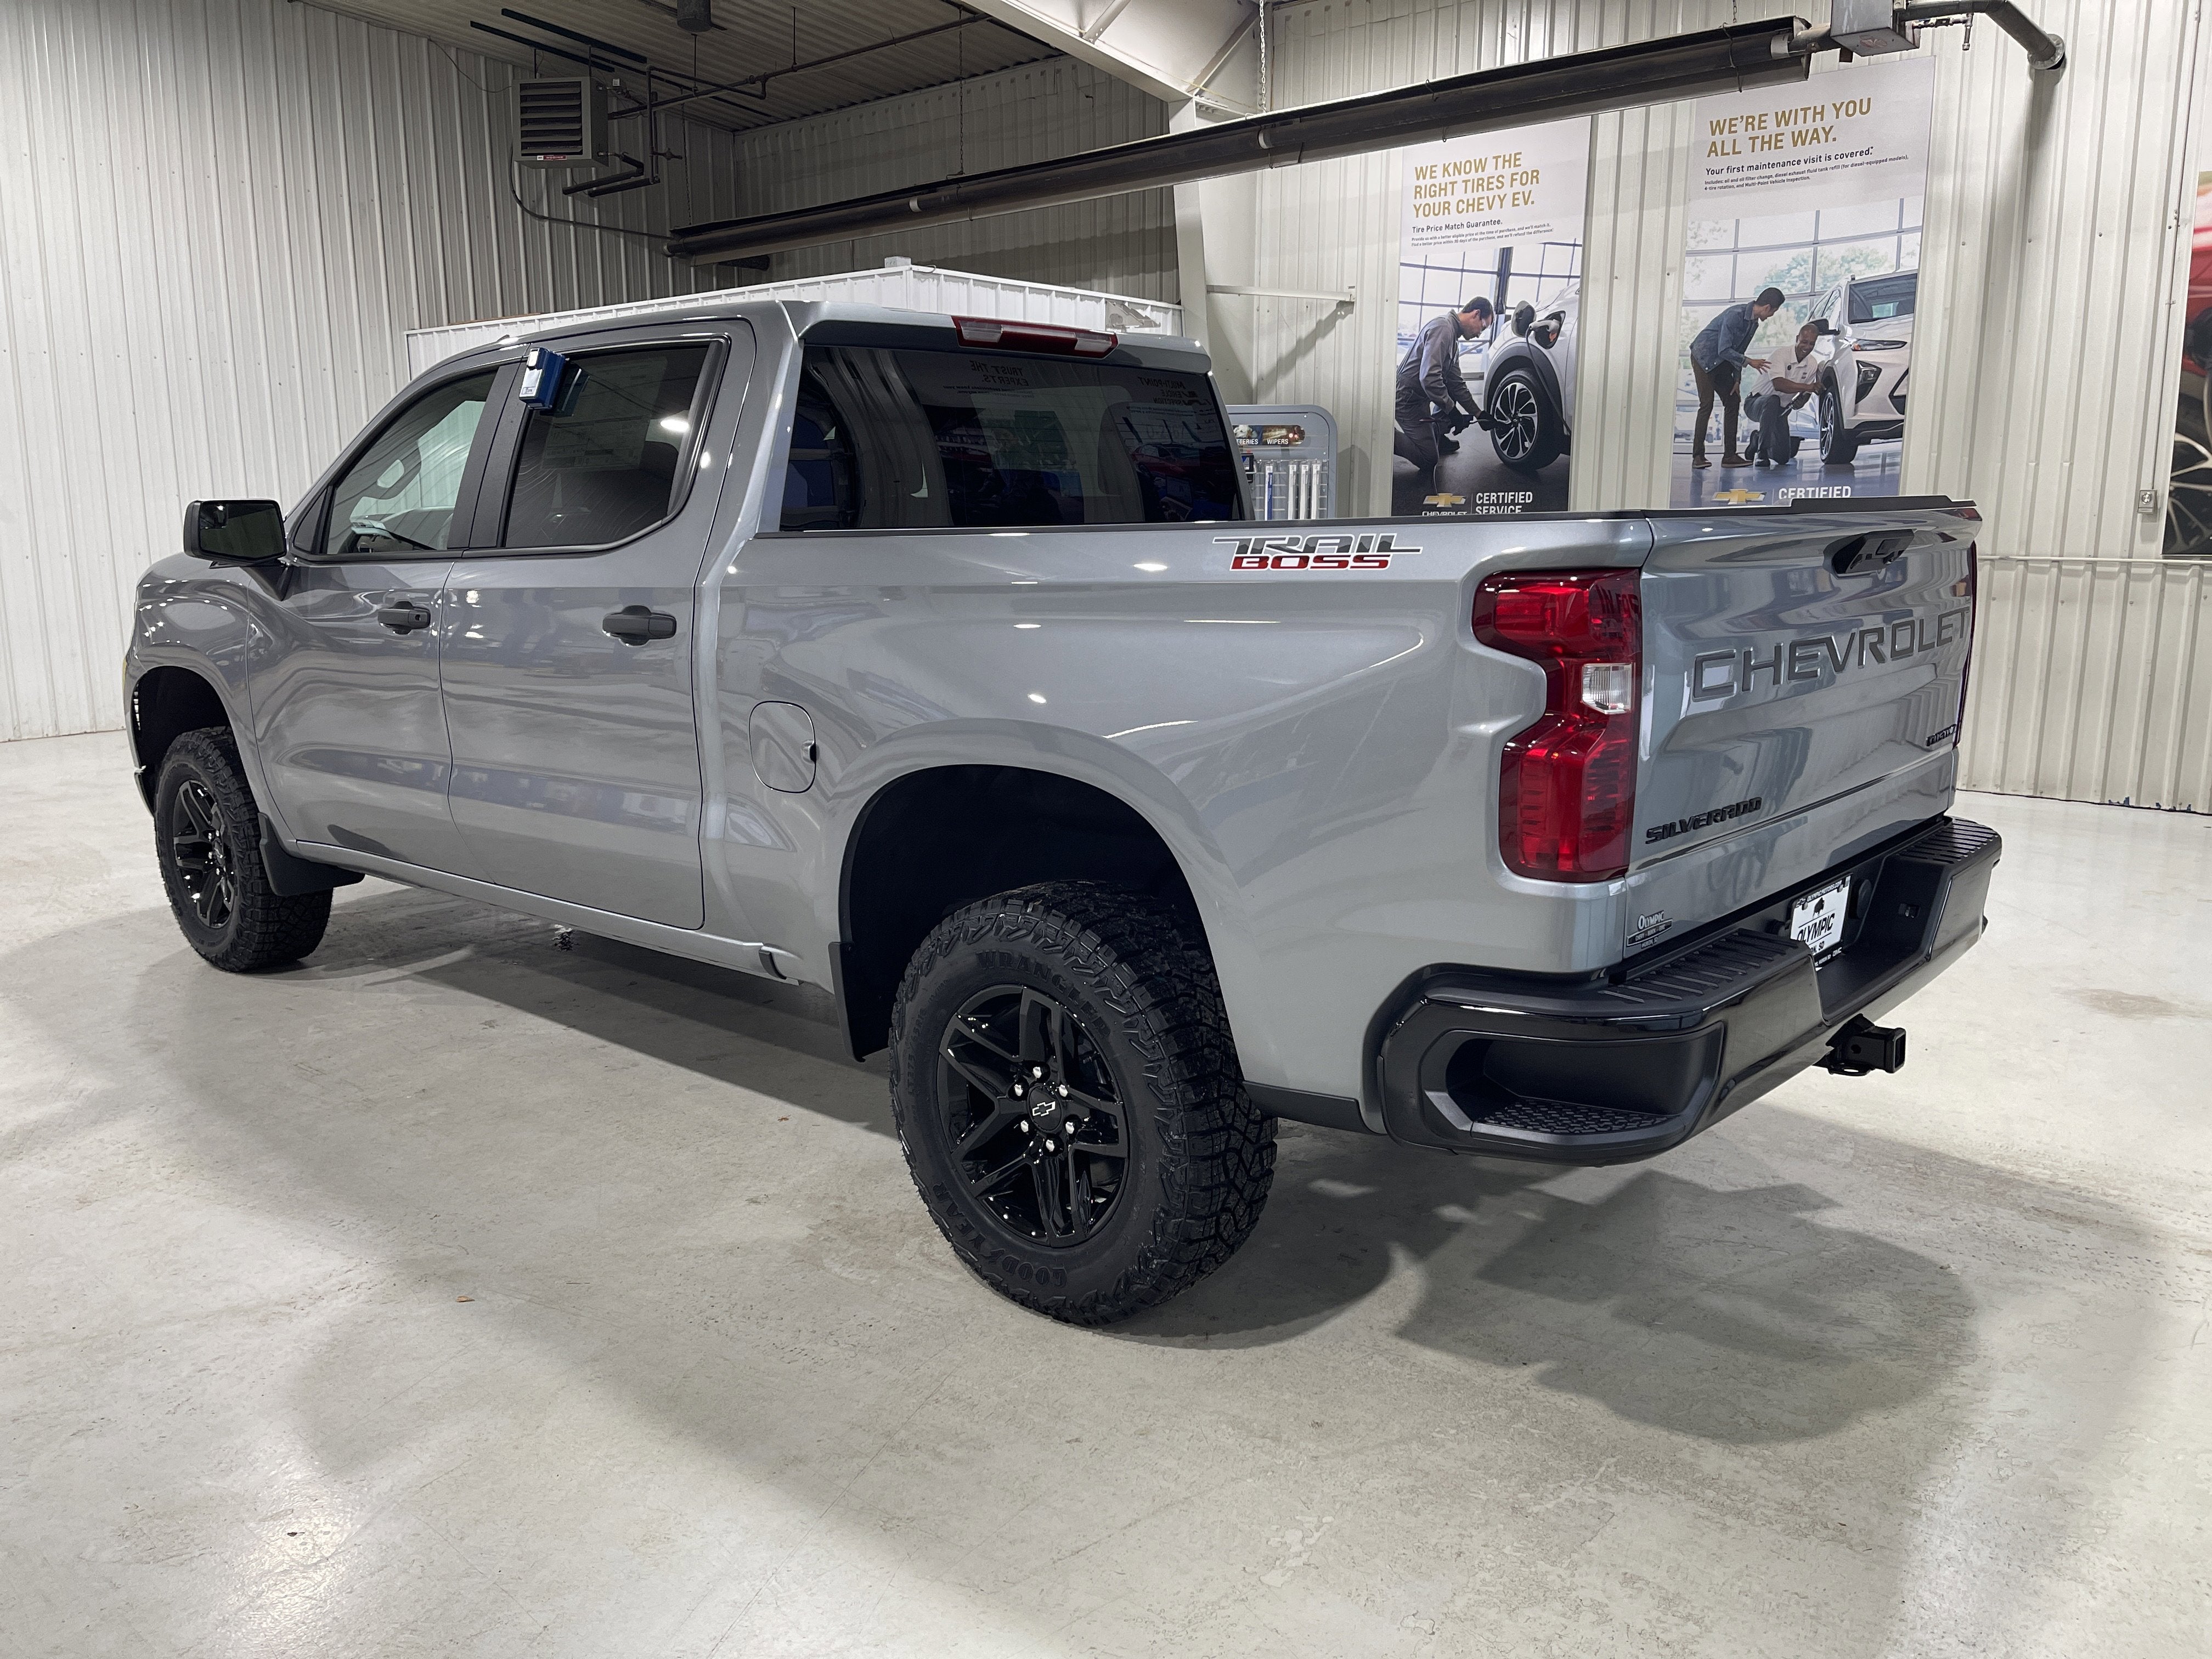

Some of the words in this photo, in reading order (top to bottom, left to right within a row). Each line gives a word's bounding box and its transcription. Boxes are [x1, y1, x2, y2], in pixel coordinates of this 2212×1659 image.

[1709, 113, 1768, 136] WE'RE
[1775, 105, 1825, 128] WITH
[1832, 97, 1871, 119] YOU
[1707, 139, 1742, 157] ALL
[1748, 132, 1785, 153] THE
[1791, 126, 1837, 147] WAY.
[1415, 165, 1437, 180] WE
[1442, 157, 1488, 178] KNOW
[1492, 151, 1522, 171] THE
[1706, 167, 1724, 176] Your
[1726, 165, 1745, 174] first
[1747, 159, 1801, 172] maintenance
[1803, 155, 1822, 164] visit
[1414, 180, 1458, 199] RIGHT
[1462, 174, 1505, 194] TIRES
[1510, 169, 1539, 188] FOR
[1413, 201, 1451, 218] YOUR
[1456, 193, 1507, 214] CHEVY
[1512, 190, 1534, 207] EV.
[1444, 222, 1464, 230] Match
[1466, 219, 1503, 229] Guarantee.
[1476, 492, 1533, 504] CERTIFIED
[1779, 486, 1852, 499] CERTIFIED
[1212, 533, 1423, 555] TRAIL
[1229, 553, 1393, 571] BOSS
[1692, 606, 1971, 702] CHEVROLET
[1645, 797, 1762, 844] SILVERADO
[1638, 911, 1664, 930] OLYMPIC
[1797, 912, 1835, 943] OLYMPIC
[976, 950, 1111, 1037] WRANGLER
